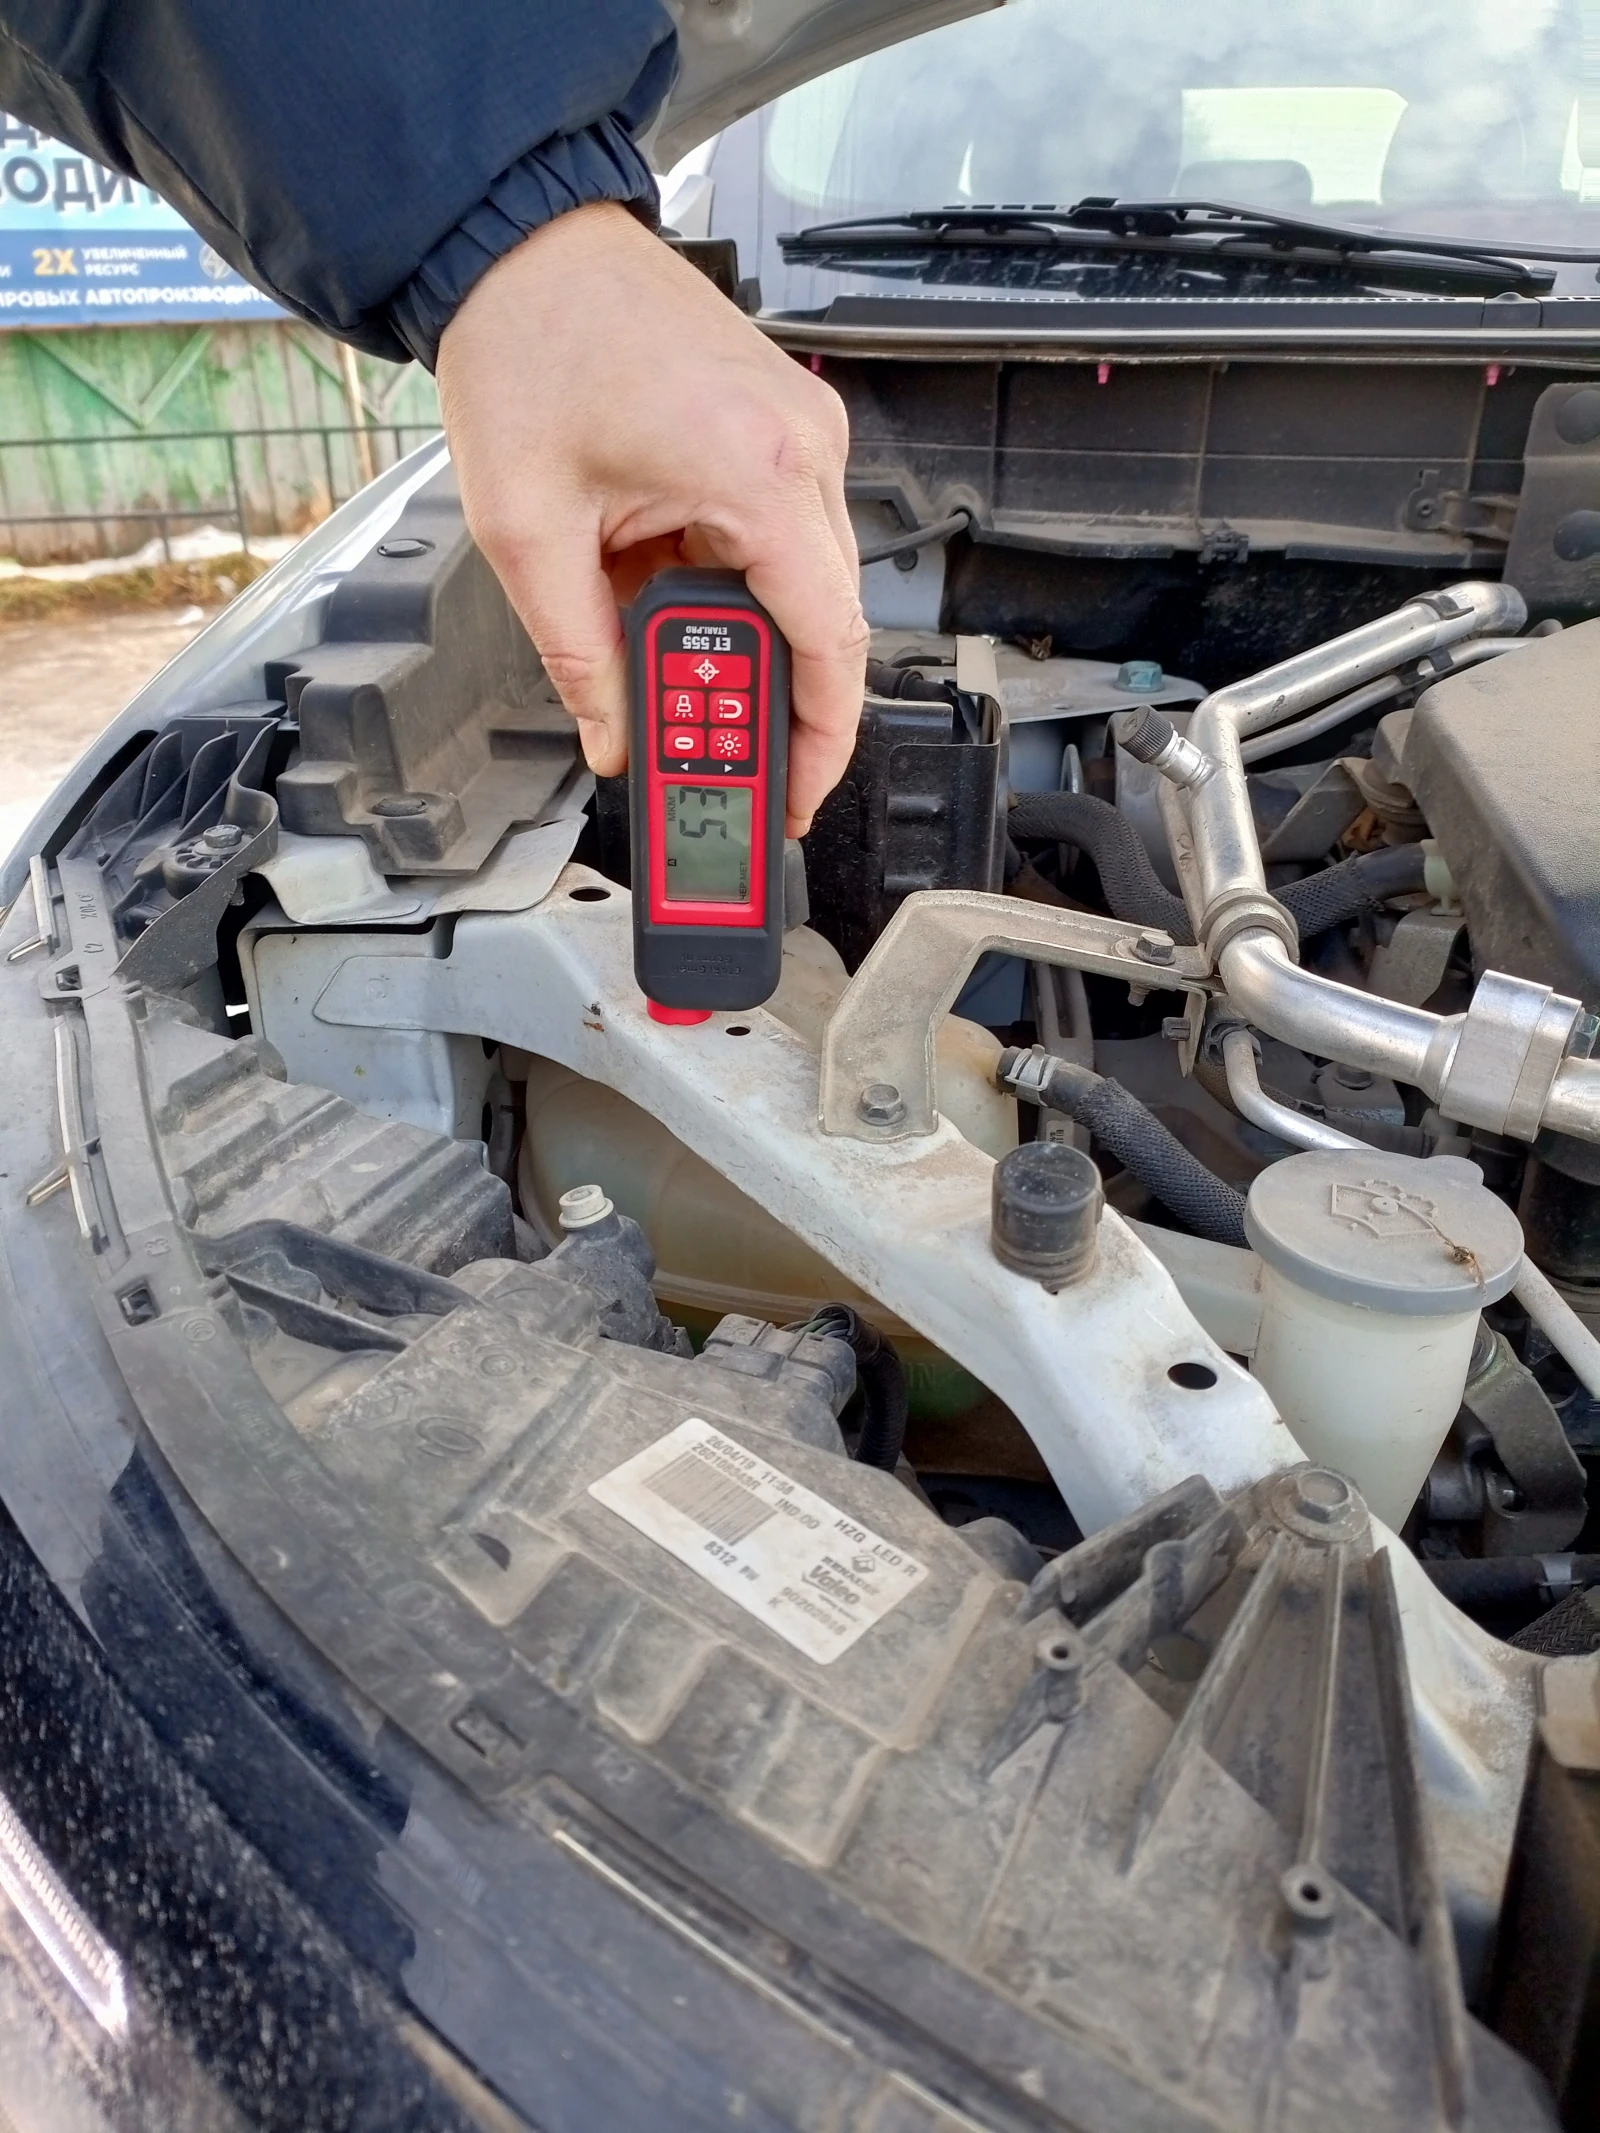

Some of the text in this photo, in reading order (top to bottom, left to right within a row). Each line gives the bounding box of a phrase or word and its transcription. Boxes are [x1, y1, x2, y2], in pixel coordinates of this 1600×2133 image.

[0, 156, 161, 212] ОДИ
[682, 635, 731, 651] ET 555
[685, 625, 728, 636] ETARI.PRO
[679, 784, 727, 840] 53
[703, 1541, 737, 1566] 8312
[872, 1544, 901, 1567] LED
[903, 1564, 917, 1576] R
[808, 1564, 859, 1605] Valeo
